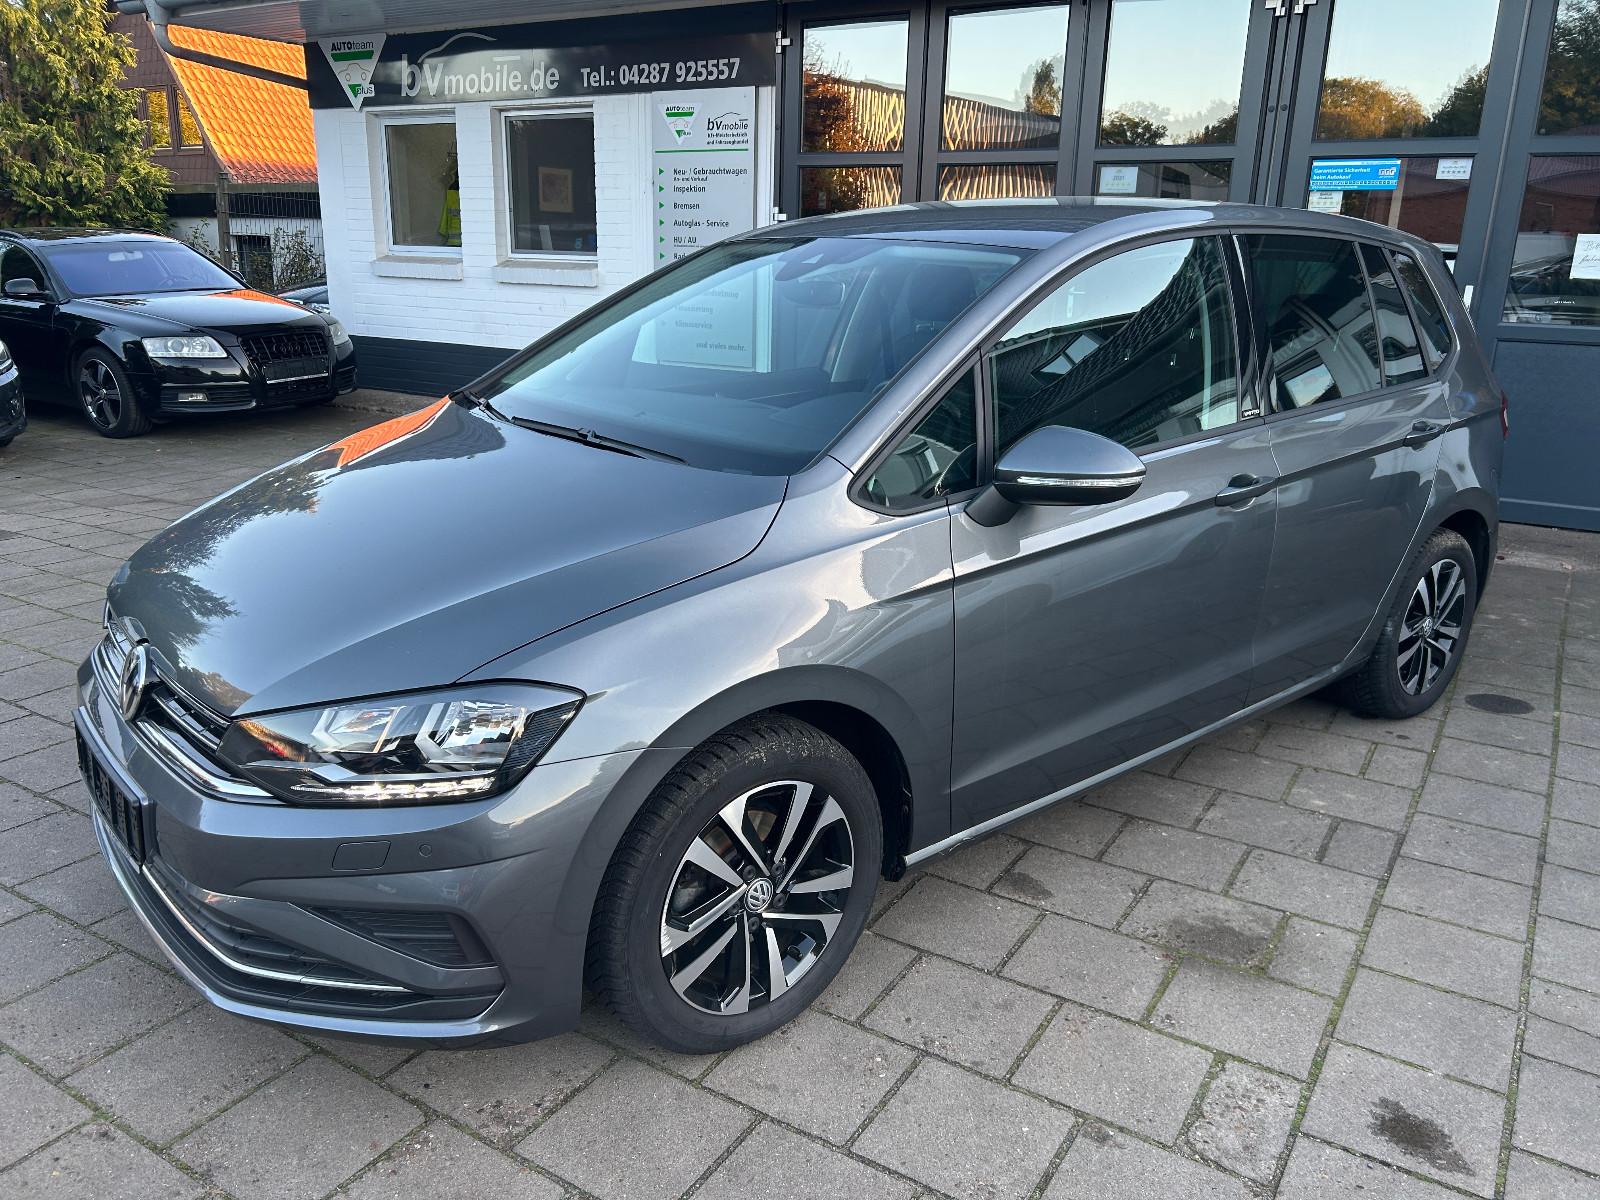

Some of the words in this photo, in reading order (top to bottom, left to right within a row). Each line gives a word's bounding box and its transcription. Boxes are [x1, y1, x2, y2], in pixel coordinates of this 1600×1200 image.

[331, 41, 374, 51] AUTOteam
[581, 66, 614, 87] Tel.:
[619, 63, 670, 85] 04287
[675, 57, 740, 82] 925557
[693, 168, 748, 177] Gebrauchtwagen
[673, 185, 706, 194] Inspektion
[673, 220, 701, 228] Autoglas
[706, 219, 730, 227] Service
[687, 236, 697, 244] AU
